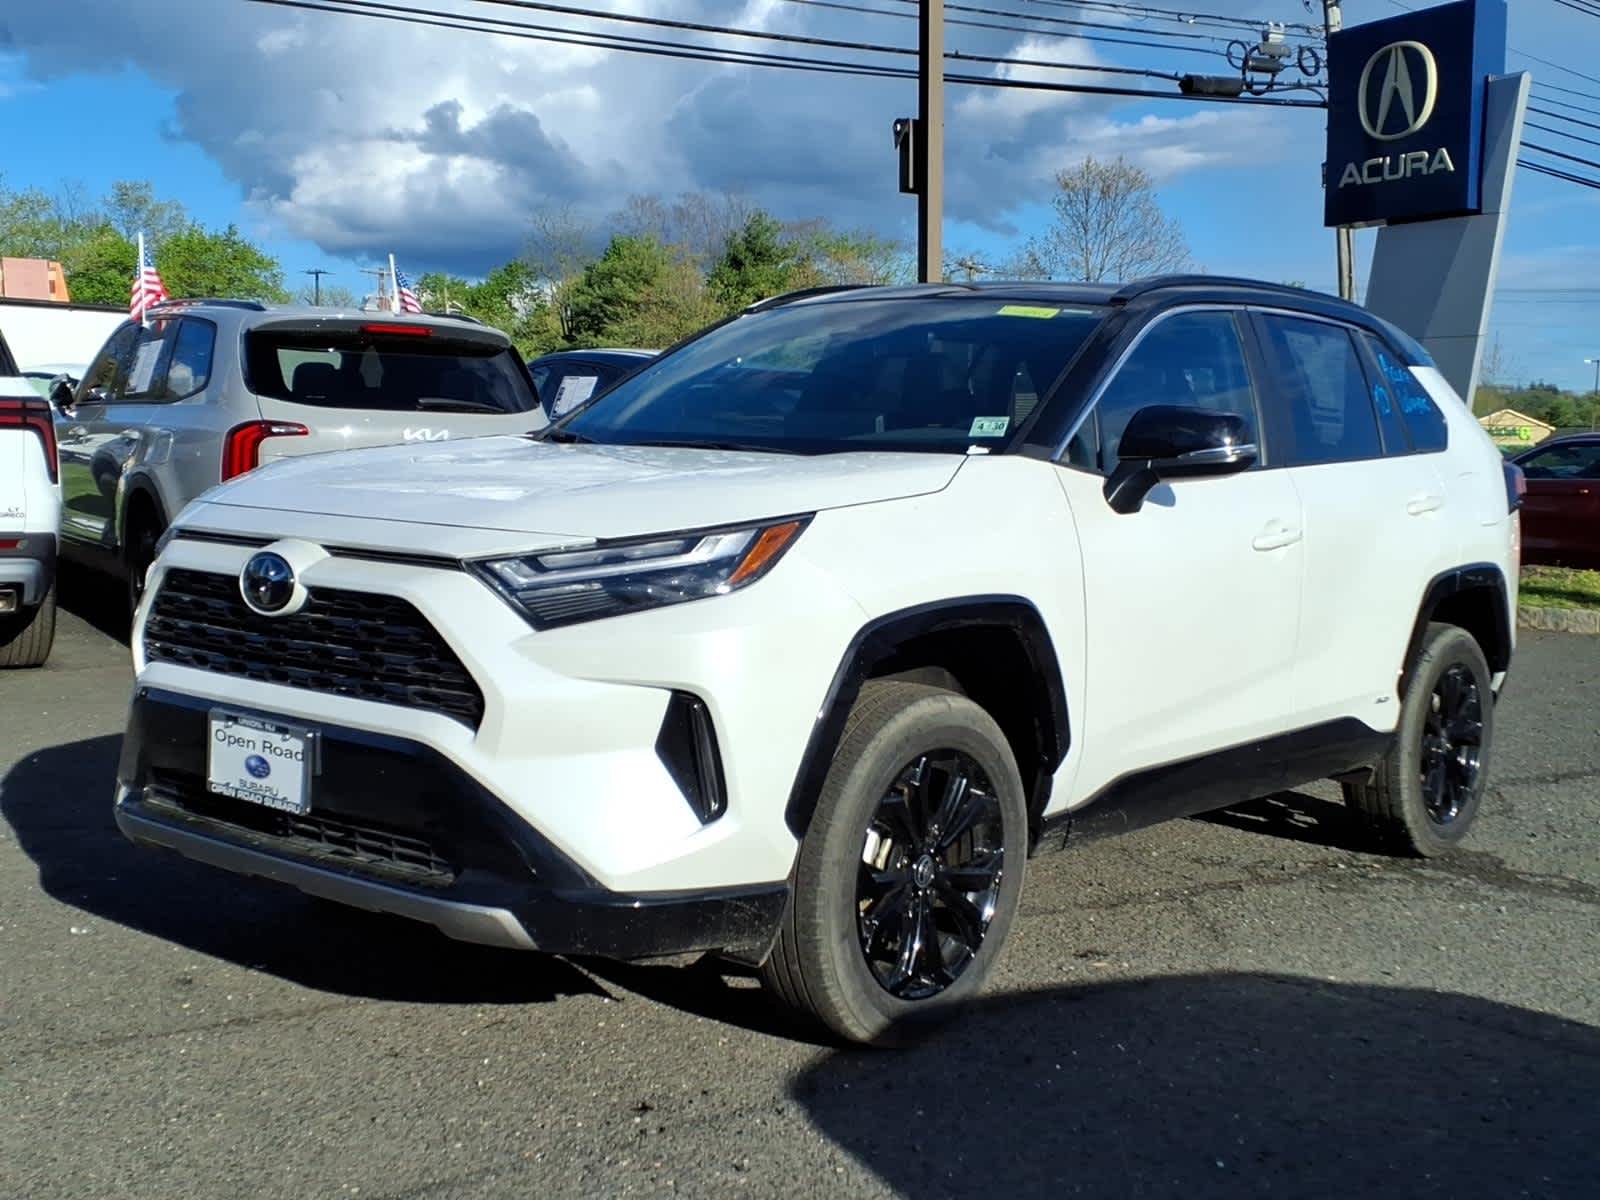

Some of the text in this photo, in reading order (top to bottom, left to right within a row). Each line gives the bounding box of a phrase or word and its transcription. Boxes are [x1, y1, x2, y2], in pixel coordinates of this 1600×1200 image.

[1339, 147, 1455, 189] ACURA
[215, 728, 304, 762] Open Road
[236, 790, 263, 804] ROAD
[239, 778, 279, 797] SUBARU
